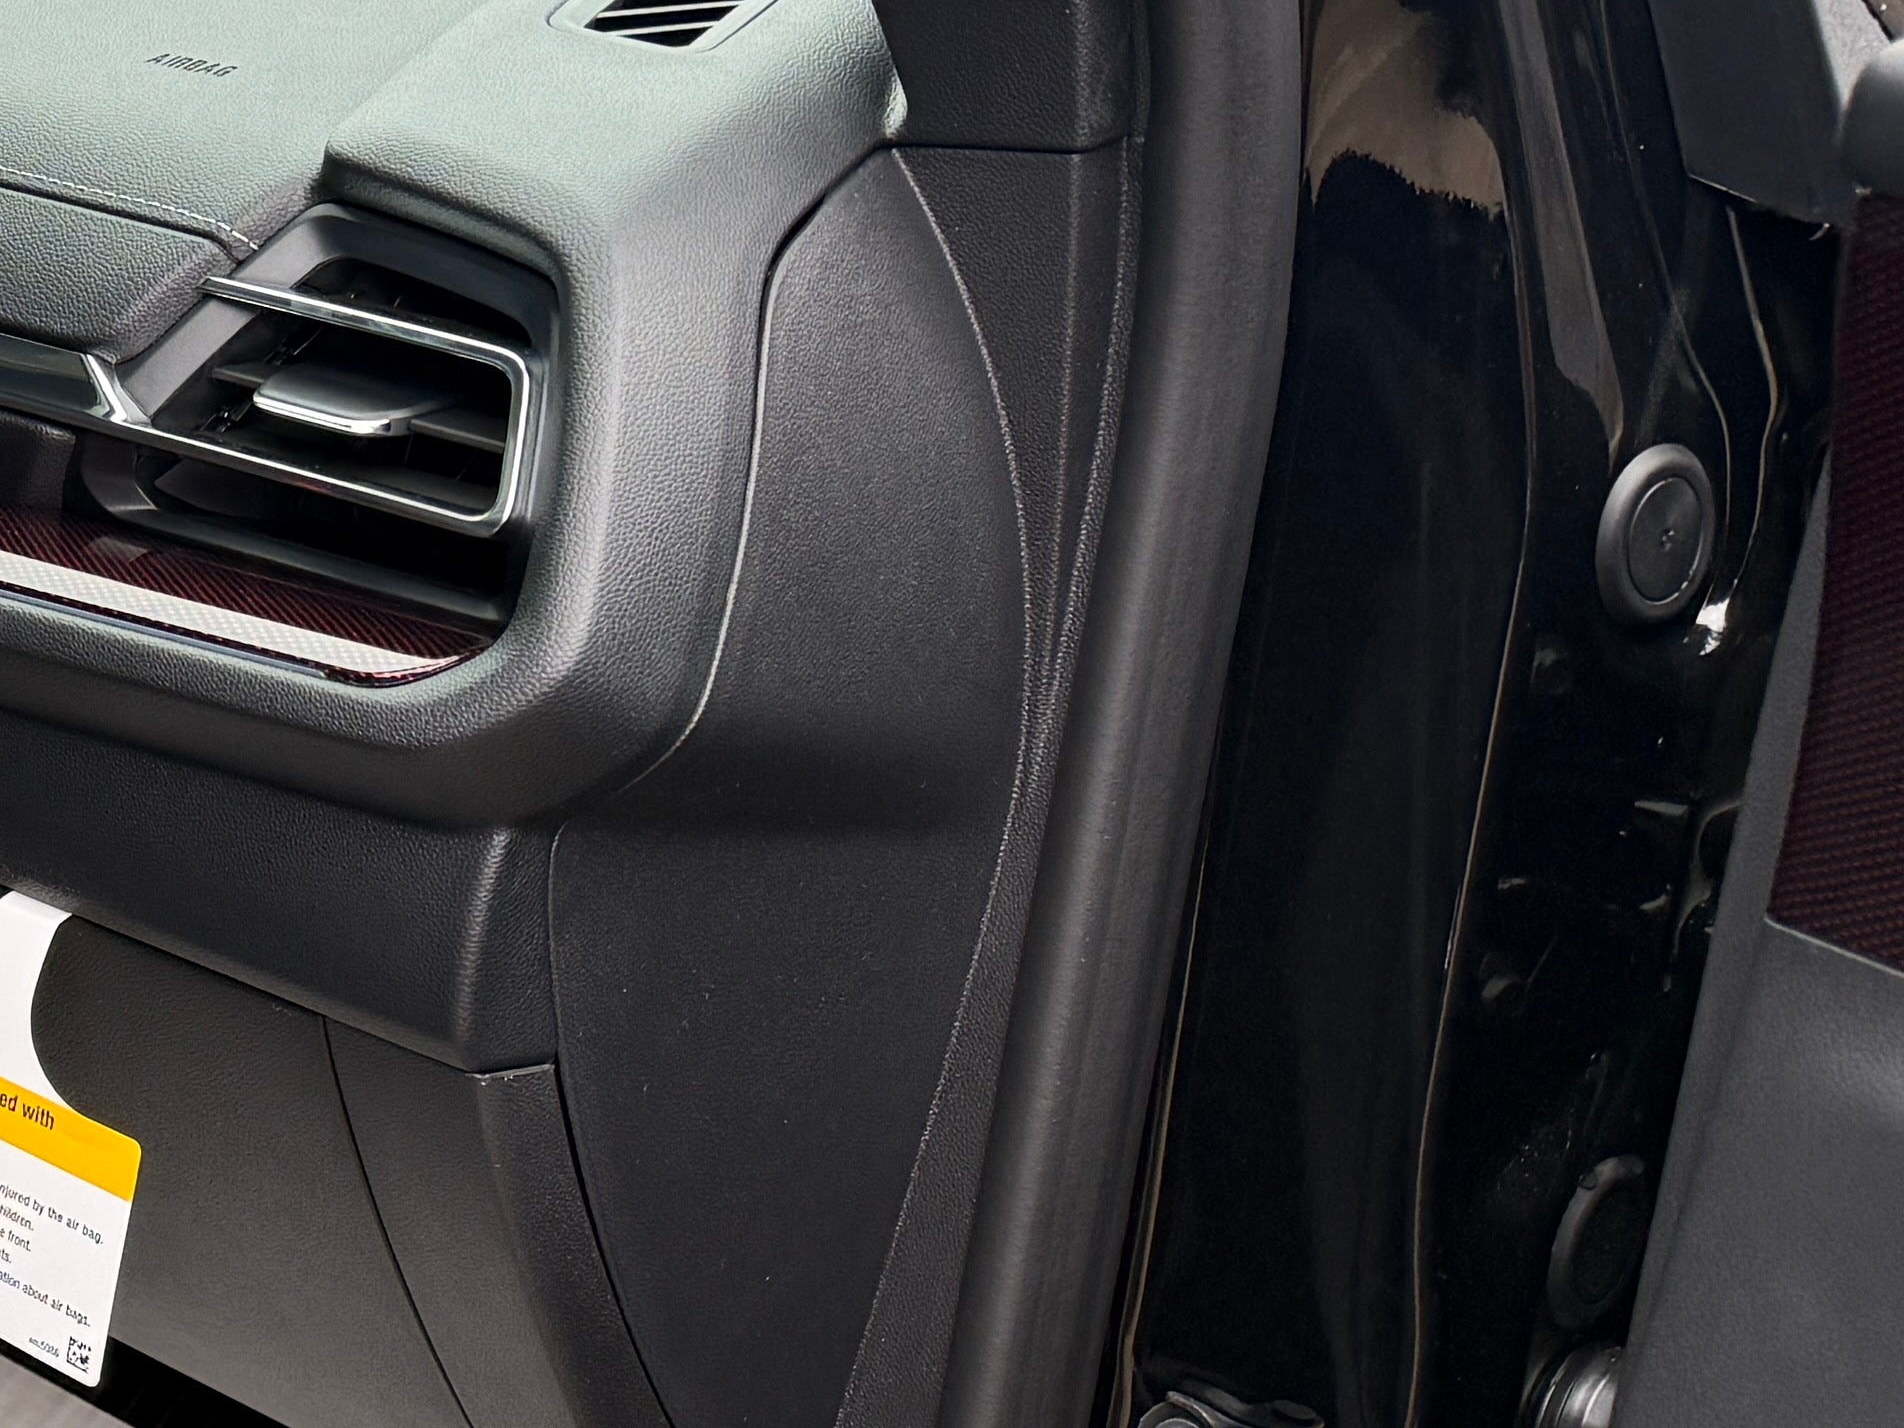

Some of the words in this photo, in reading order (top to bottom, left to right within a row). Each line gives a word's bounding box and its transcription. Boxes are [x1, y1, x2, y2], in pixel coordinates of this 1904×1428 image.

[144, 53, 238, 77] AIRBAG
[21, 1100, 55, 1131] with
[31, 1199, 44, 1216] by
[47, 1206, 63, 1224] the
[65, 1216, 79, 1232] air
[81, 1224, 104, 1247] bag.
[7, 1230, 32, 1252] front.
